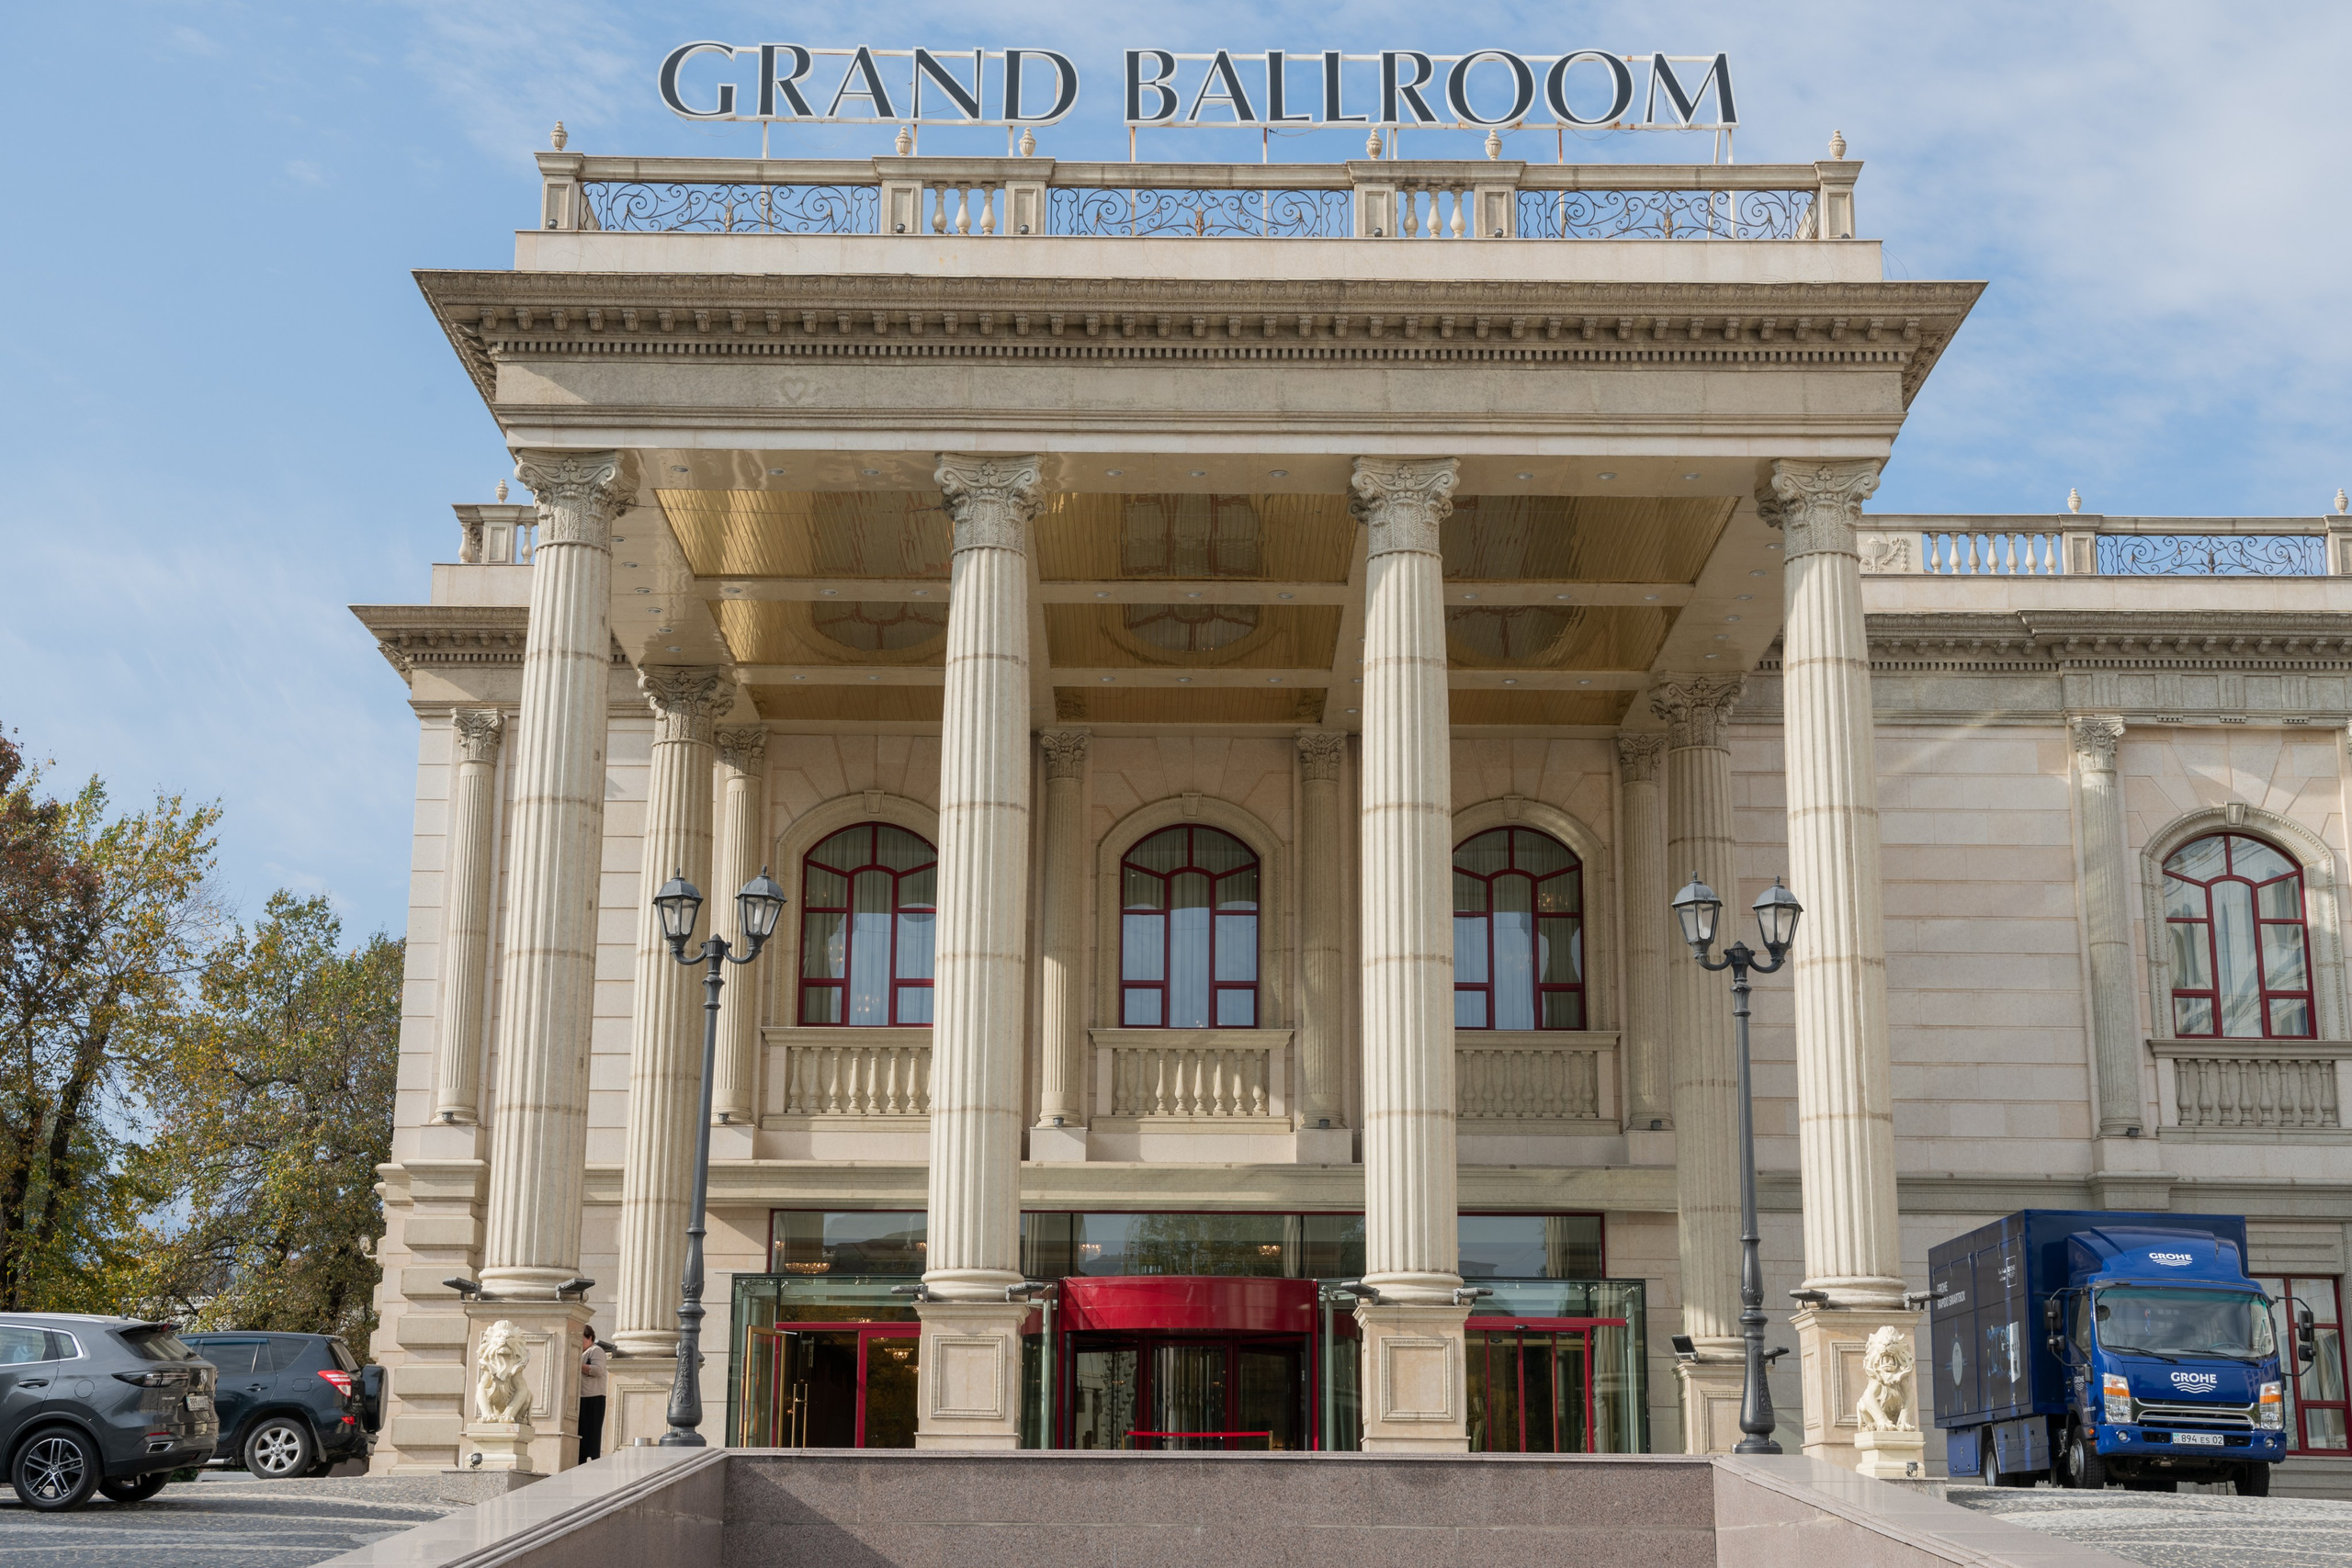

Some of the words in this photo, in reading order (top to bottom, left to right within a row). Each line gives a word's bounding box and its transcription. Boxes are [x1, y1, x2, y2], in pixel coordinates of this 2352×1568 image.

[658, 39, 1080, 128] GRAND
[1124, 48, 1739, 130] BALLROOM
[2149, 1252, 2193, 1260] GROHE
[1937, 1281, 1948, 1293] GROHE
[2170, 1371, 2218, 1383] GROHE
[2181, 1434, 2197, 1443] 894
[2212, 1436, 2223, 1445] 02
